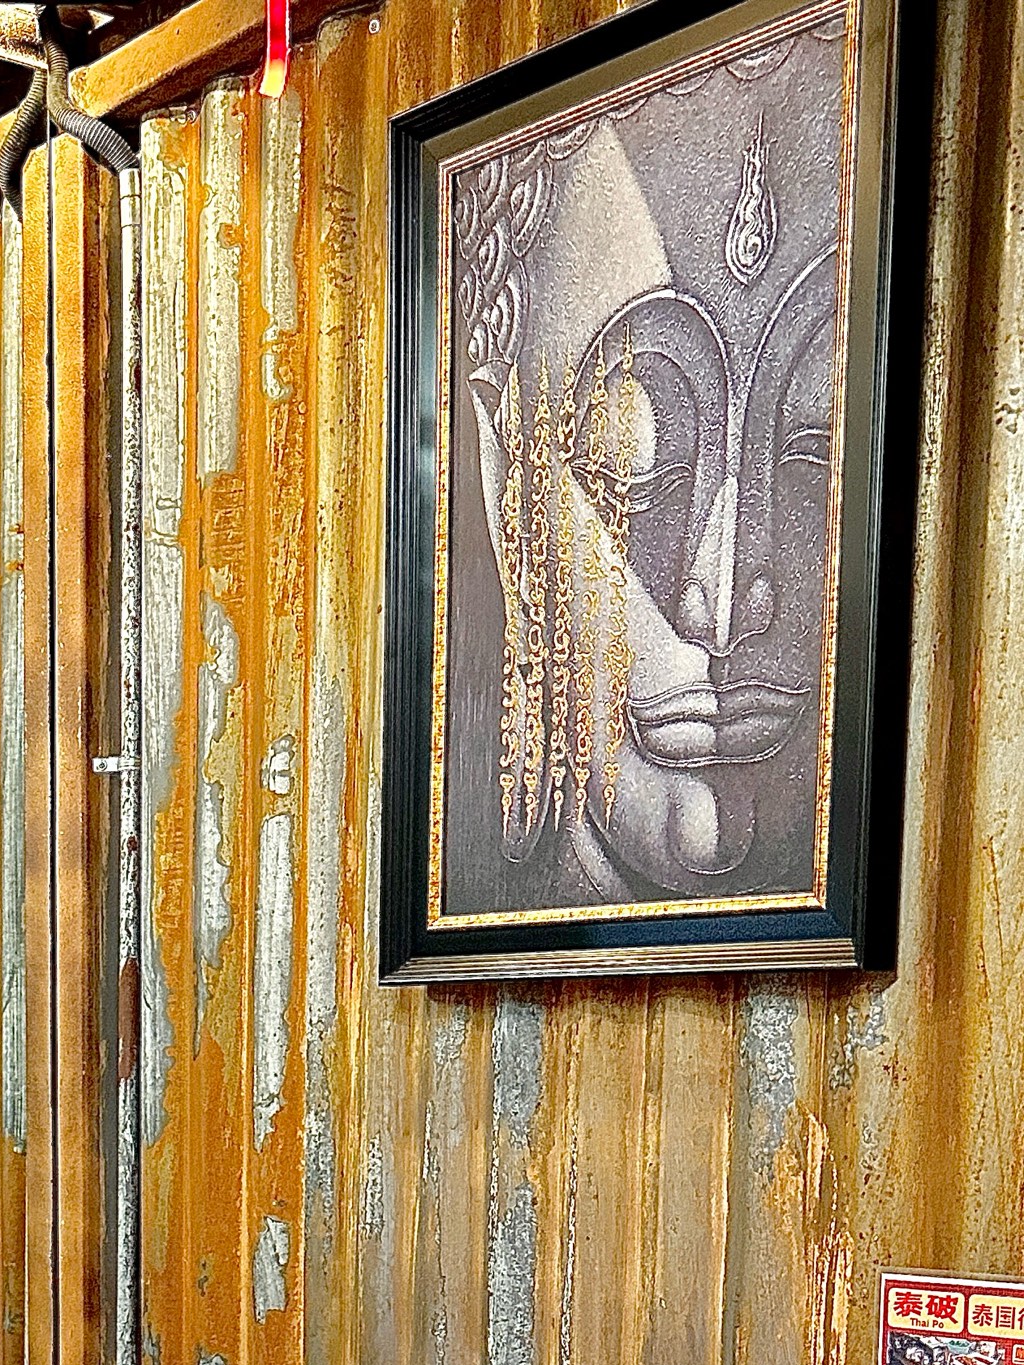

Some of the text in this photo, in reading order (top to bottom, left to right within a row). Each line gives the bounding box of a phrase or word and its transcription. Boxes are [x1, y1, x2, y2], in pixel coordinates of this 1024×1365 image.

[893, 1291, 959, 1325] 泰破
[910, 1317, 945, 1329] Thai Po
